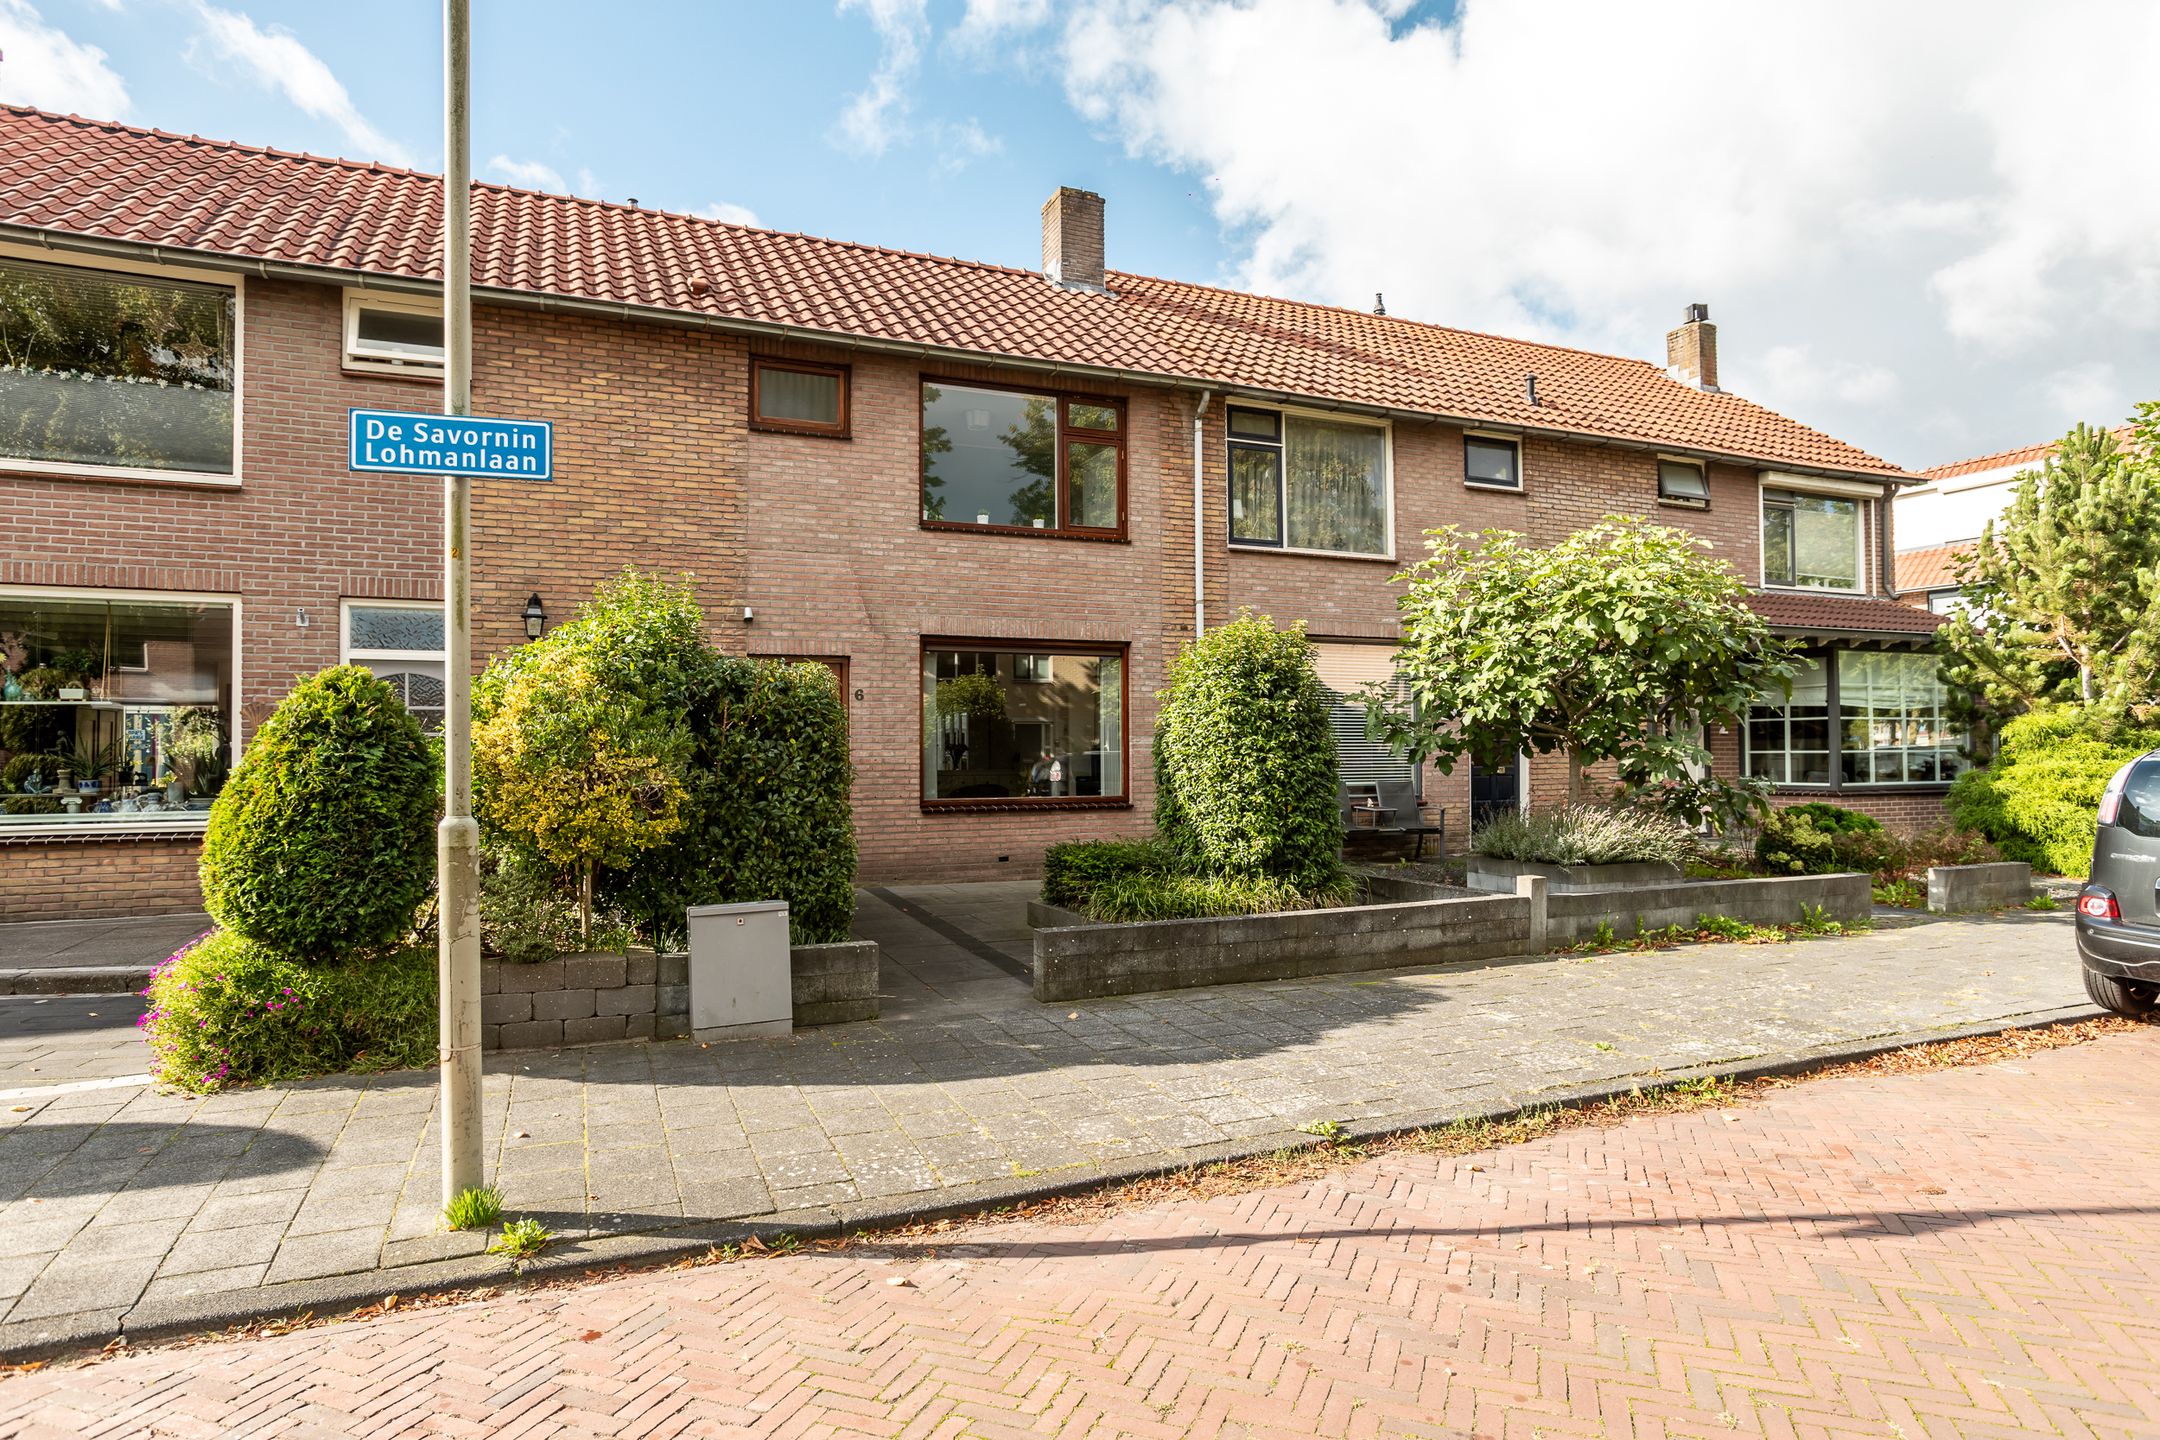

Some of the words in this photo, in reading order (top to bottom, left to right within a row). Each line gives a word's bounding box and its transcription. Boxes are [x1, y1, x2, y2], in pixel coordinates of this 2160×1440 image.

[366, 419, 402, 441] De
[413, 422, 536, 449] Savornin
[366, 442, 537, 471] Lohmanlaan
[854, 688, 865, 702] 6
